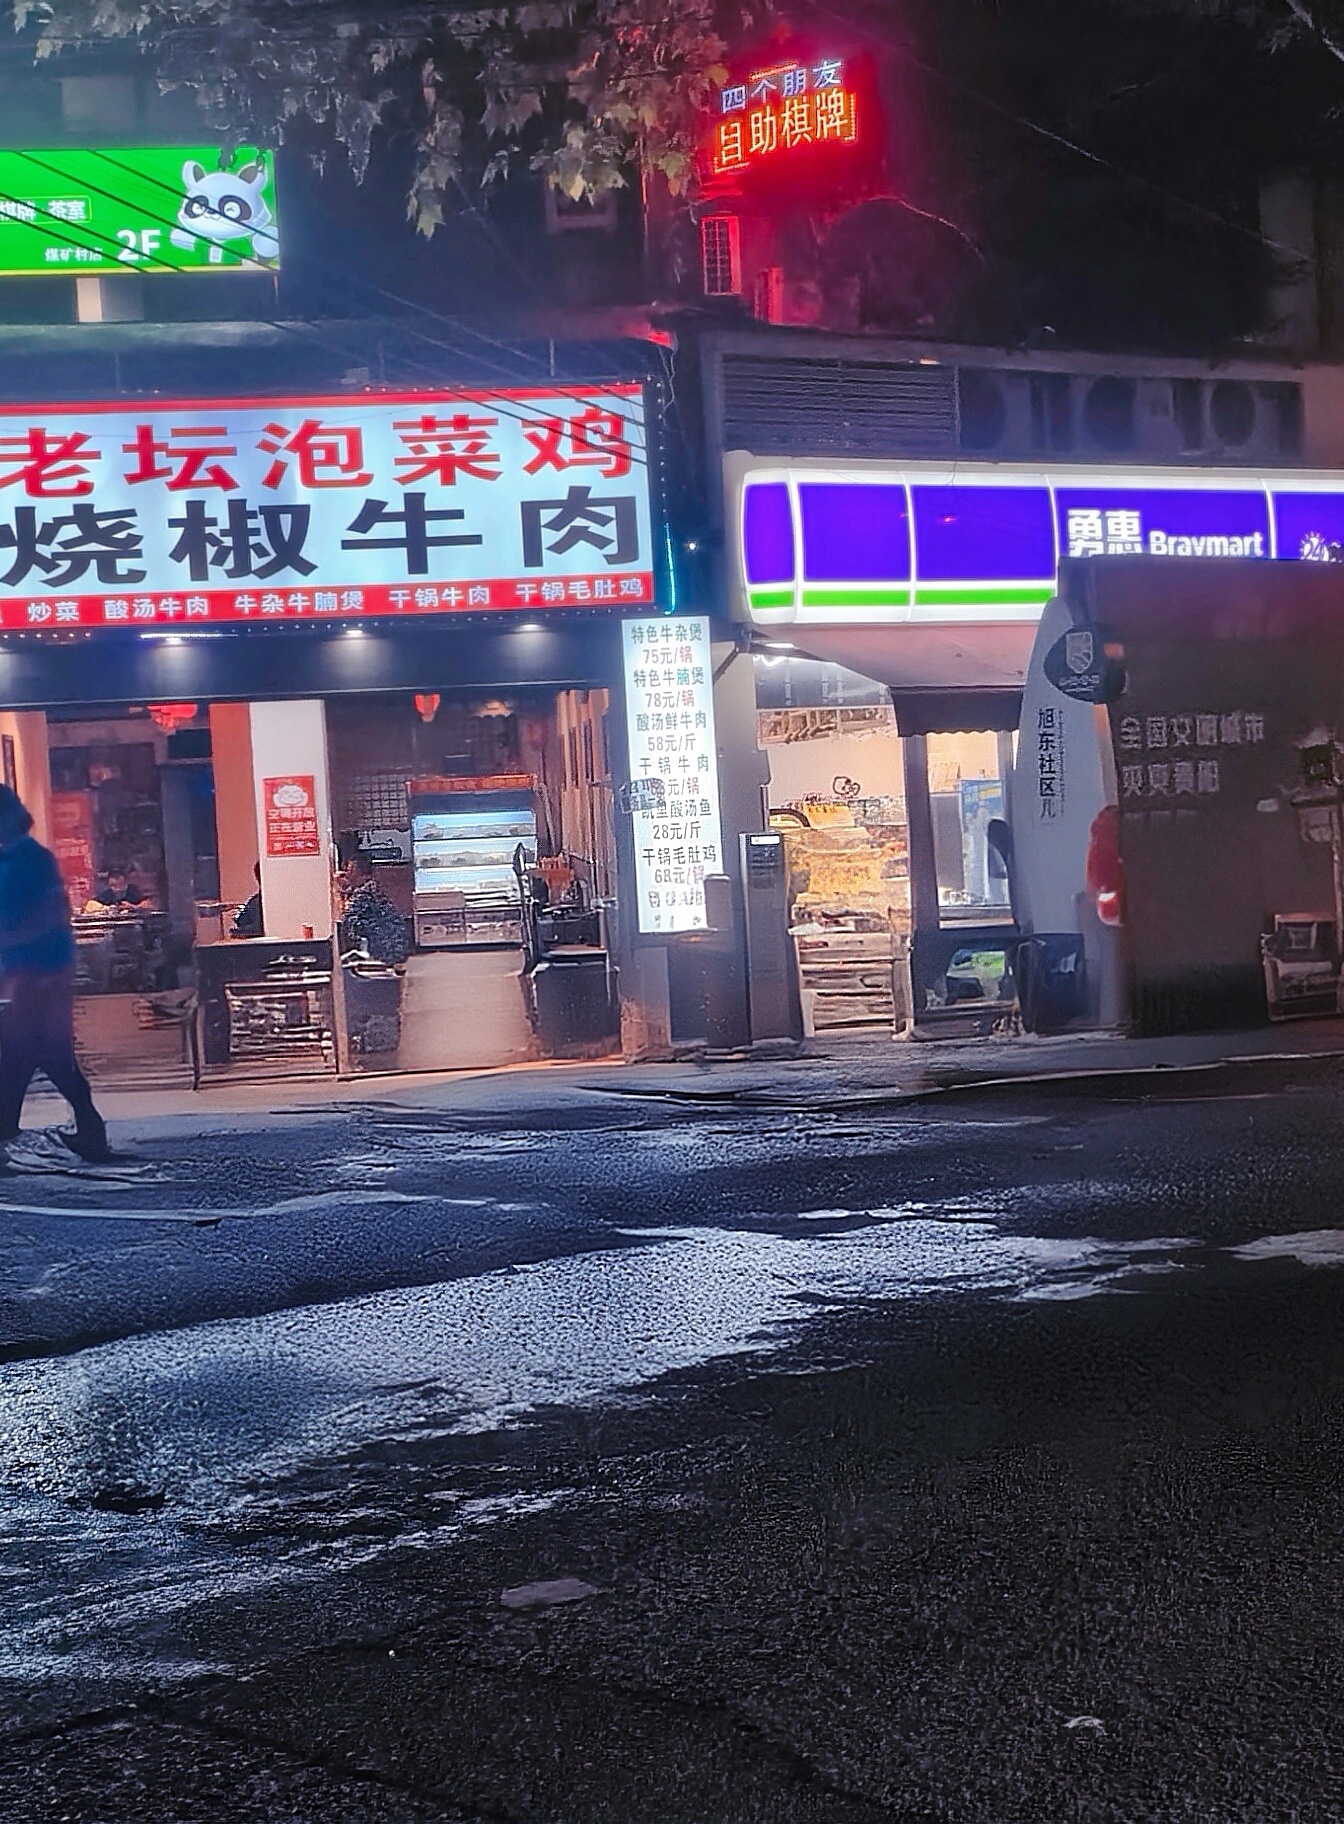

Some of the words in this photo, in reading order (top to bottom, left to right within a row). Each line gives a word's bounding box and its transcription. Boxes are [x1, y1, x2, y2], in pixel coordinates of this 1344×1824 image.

[721, 60, 843, 114] 四个朋友
[720, 89, 849, 165] 自助棋牌
[116, 229, 162, 261] 2F
[28, 601, 80, 623] 炒菜
[104, 595, 209, 620] 酸汤牛肉
[234, 590, 364, 615] 牛杂牛腩煲
[389, 585, 491, 609] 干锅牛肉
[515, 577, 644, 602] 干锅毛肚鸡
[631, 623, 702, 644] 特色牛杂煲
[643, 645, 693, 665] 75元/锅
[633, 667, 705, 688] 特色牛腩煲
[645, 690, 695, 708] 78元/锅
[636, 710, 706, 732] 酸汤鲜牛肉
[648, 733, 696, 752] 58元/斤
[639, 754, 709, 776] 干锅牛肉
[653, 821, 701, 840] 28元/斤
[642, 845, 717, 866] 干锅毛肚鸡
